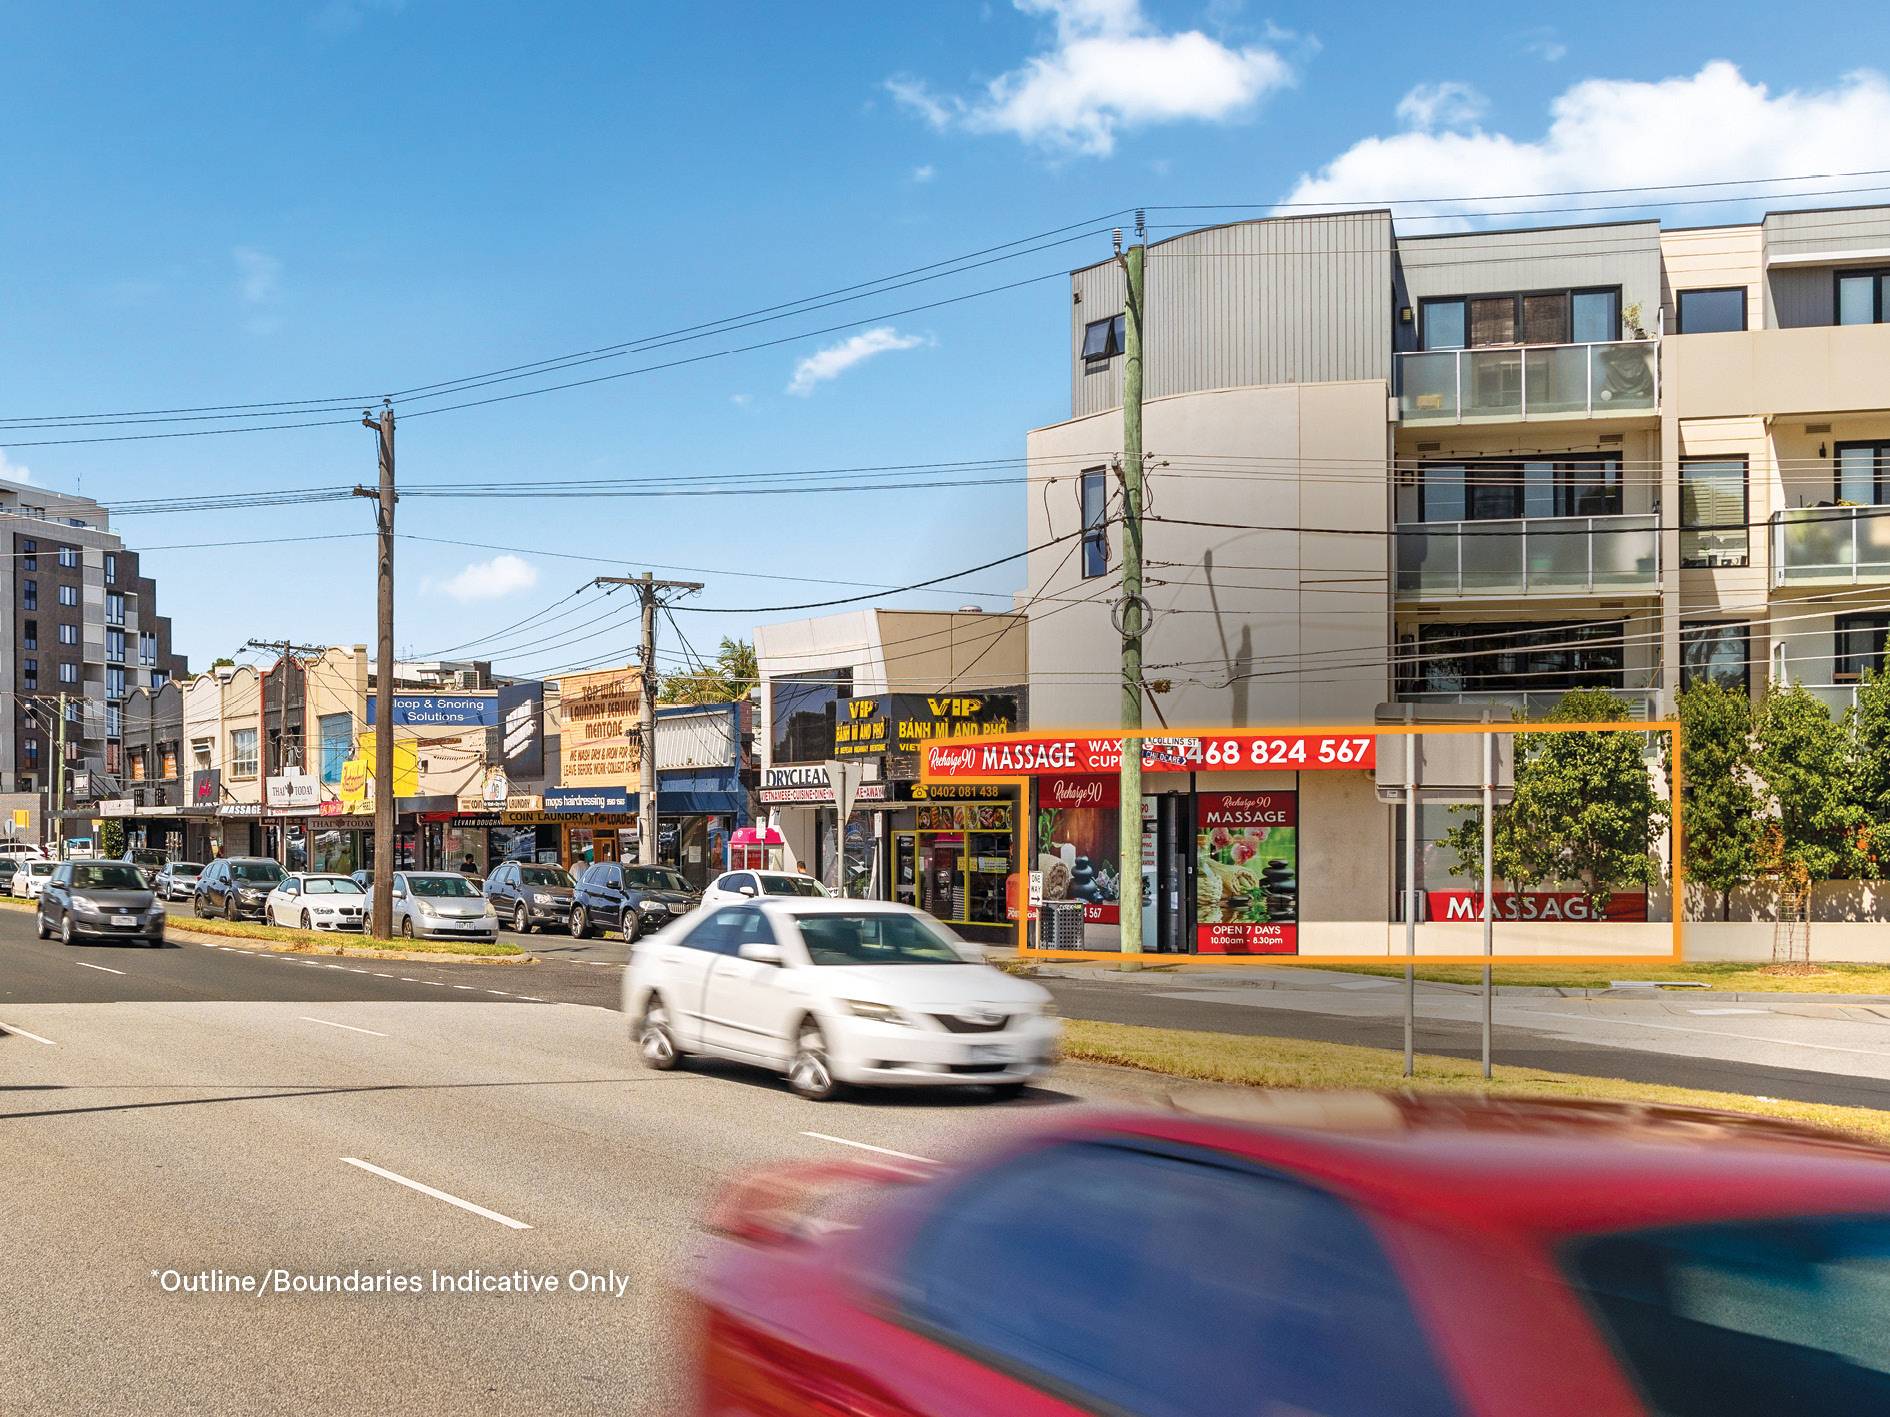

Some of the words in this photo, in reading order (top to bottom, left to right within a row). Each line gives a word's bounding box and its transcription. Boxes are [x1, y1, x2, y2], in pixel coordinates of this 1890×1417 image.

[393, 699, 420, 710] leep
[424, 699, 433, 708] &
[437, 699, 484, 710] Snoring
[849, 700, 875, 719] VIP
[927, 698, 983, 716] VIP
[408, 711, 464, 721] Solutions
[570, 703, 605, 722] LAUNDRY
[607, 699, 639, 718] SERVICES
[585, 720, 622, 739] MENTONE
[899, 718, 931, 738] BÁNH
[935, 719, 949, 738] MÌ
[953, 721, 978, 736] AND
[1152, 737, 1185, 745] COLLINS
[981, 743, 1076, 770] MASSAGE
[1250, 740, 1306, 764] 824
[1318, 739, 1370, 763] 567
[272, 786, 285, 797] THAI
[294, 786, 313, 796] TODAY
[930, 786, 956, 797] 0402
[958, 786, 976, 797] 081
[979, 786, 998, 797] 438
[508, 799, 530, 809] LAUNDRY
[545, 797, 563, 809] mops
[563, 794, 605, 808] hairdressing
[221, 805, 262, 814] MASSAGE
[509, 812, 533, 821] COIN
[538, 812, 584, 821] LAUNDRY
[1206, 811, 1286, 823] MASSAGE
[312, 820, 333, 828] THAI
[346, 820, 374, 828] TODAY
[1031, 874, 1041, 883] ONE
[1089, 907, 1102, 918] 567
[1212, 925, 1243, 935] OPEN
[1246, 926, 1252, 934] 7
[1254, 925, 1281, 935] DAYS
[1210, 936, 1244, 944] 10.00am
[1252, 936, 1283, 945] 8.30pm
